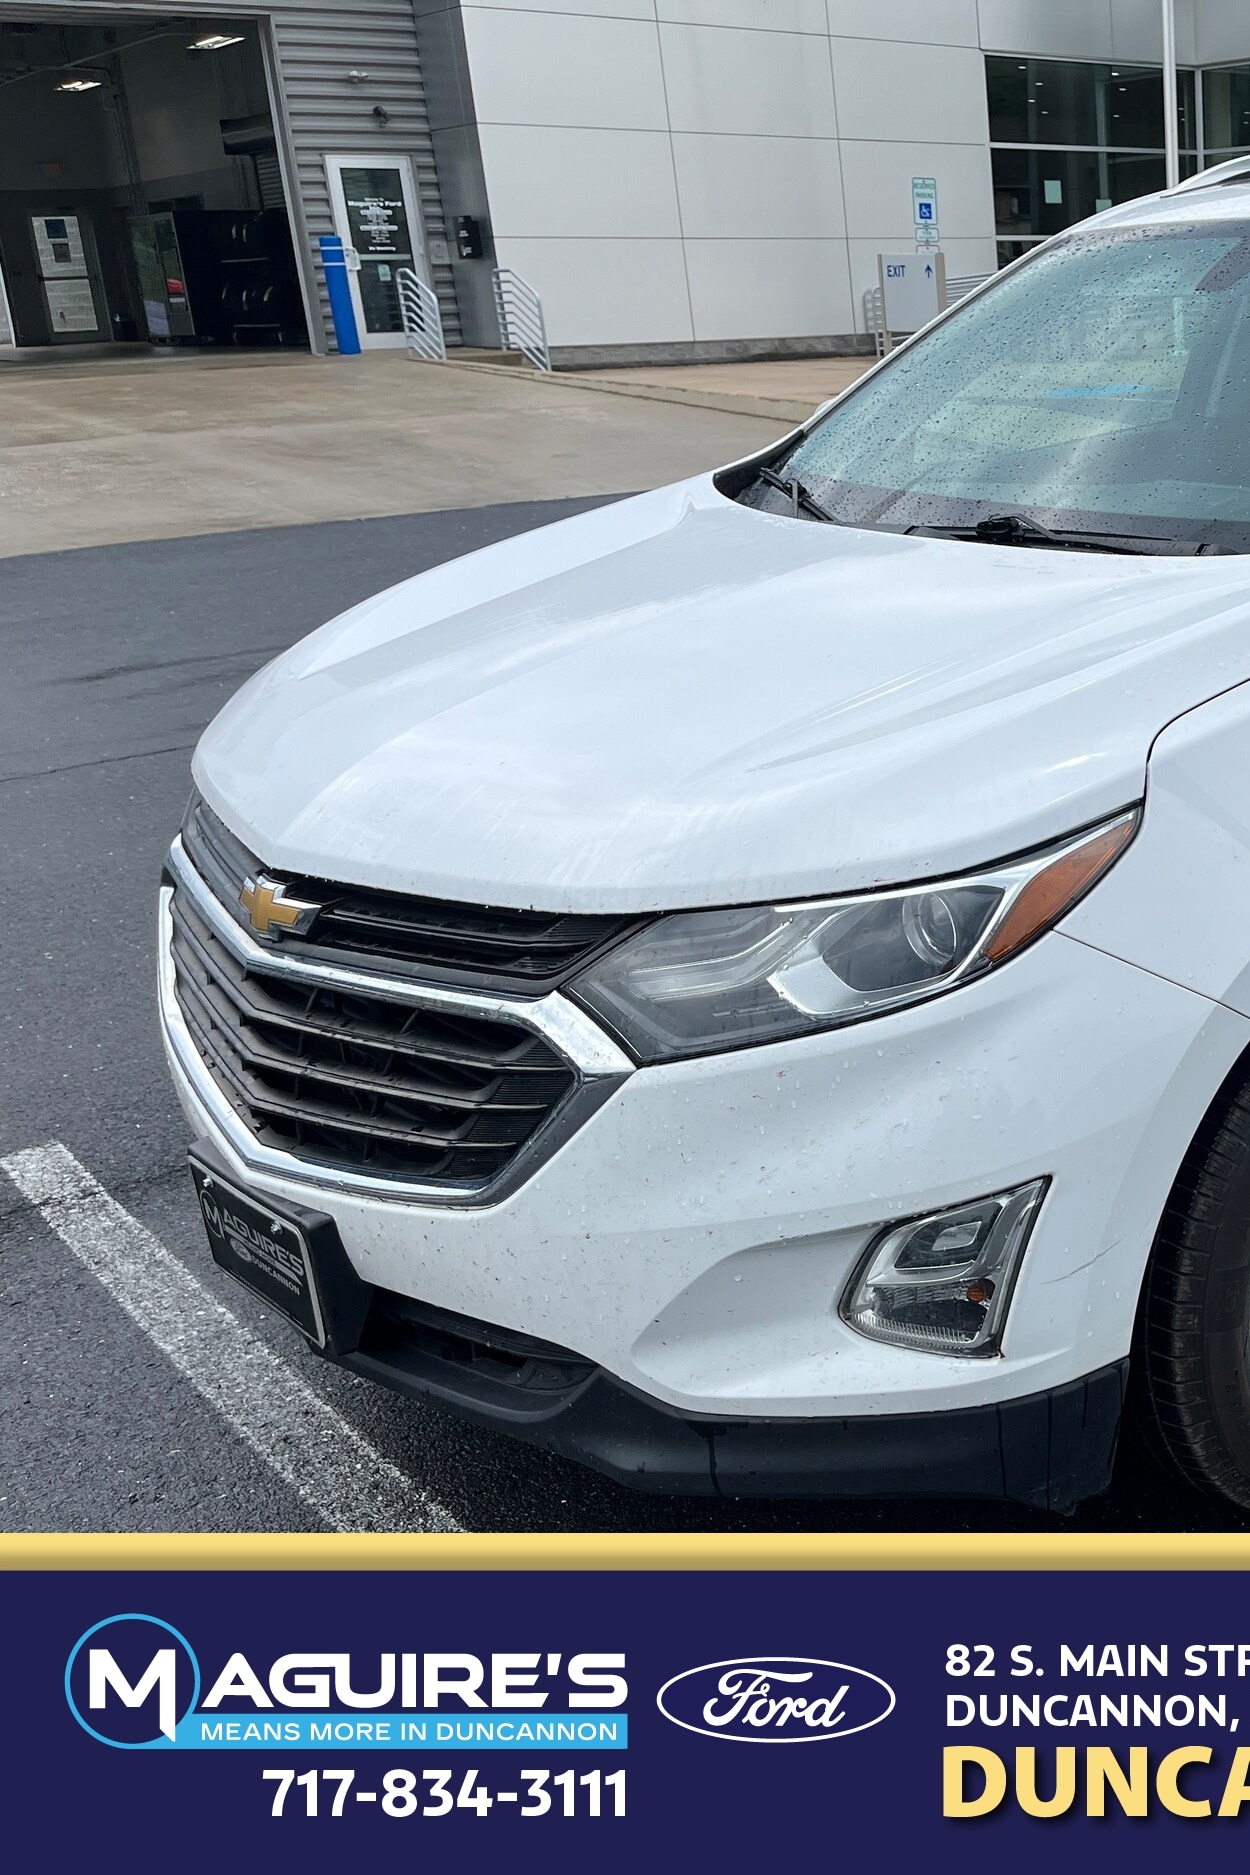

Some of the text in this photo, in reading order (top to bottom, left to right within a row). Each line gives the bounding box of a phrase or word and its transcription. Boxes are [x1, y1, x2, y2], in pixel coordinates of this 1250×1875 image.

[915, 191, 934, 199] PARKING
[887, 264, 906, 278] EXIT
[202, 1196, 305, 1278] MAGUIRE'S
[251, 1255, 301, 1296] DUNCANNON
